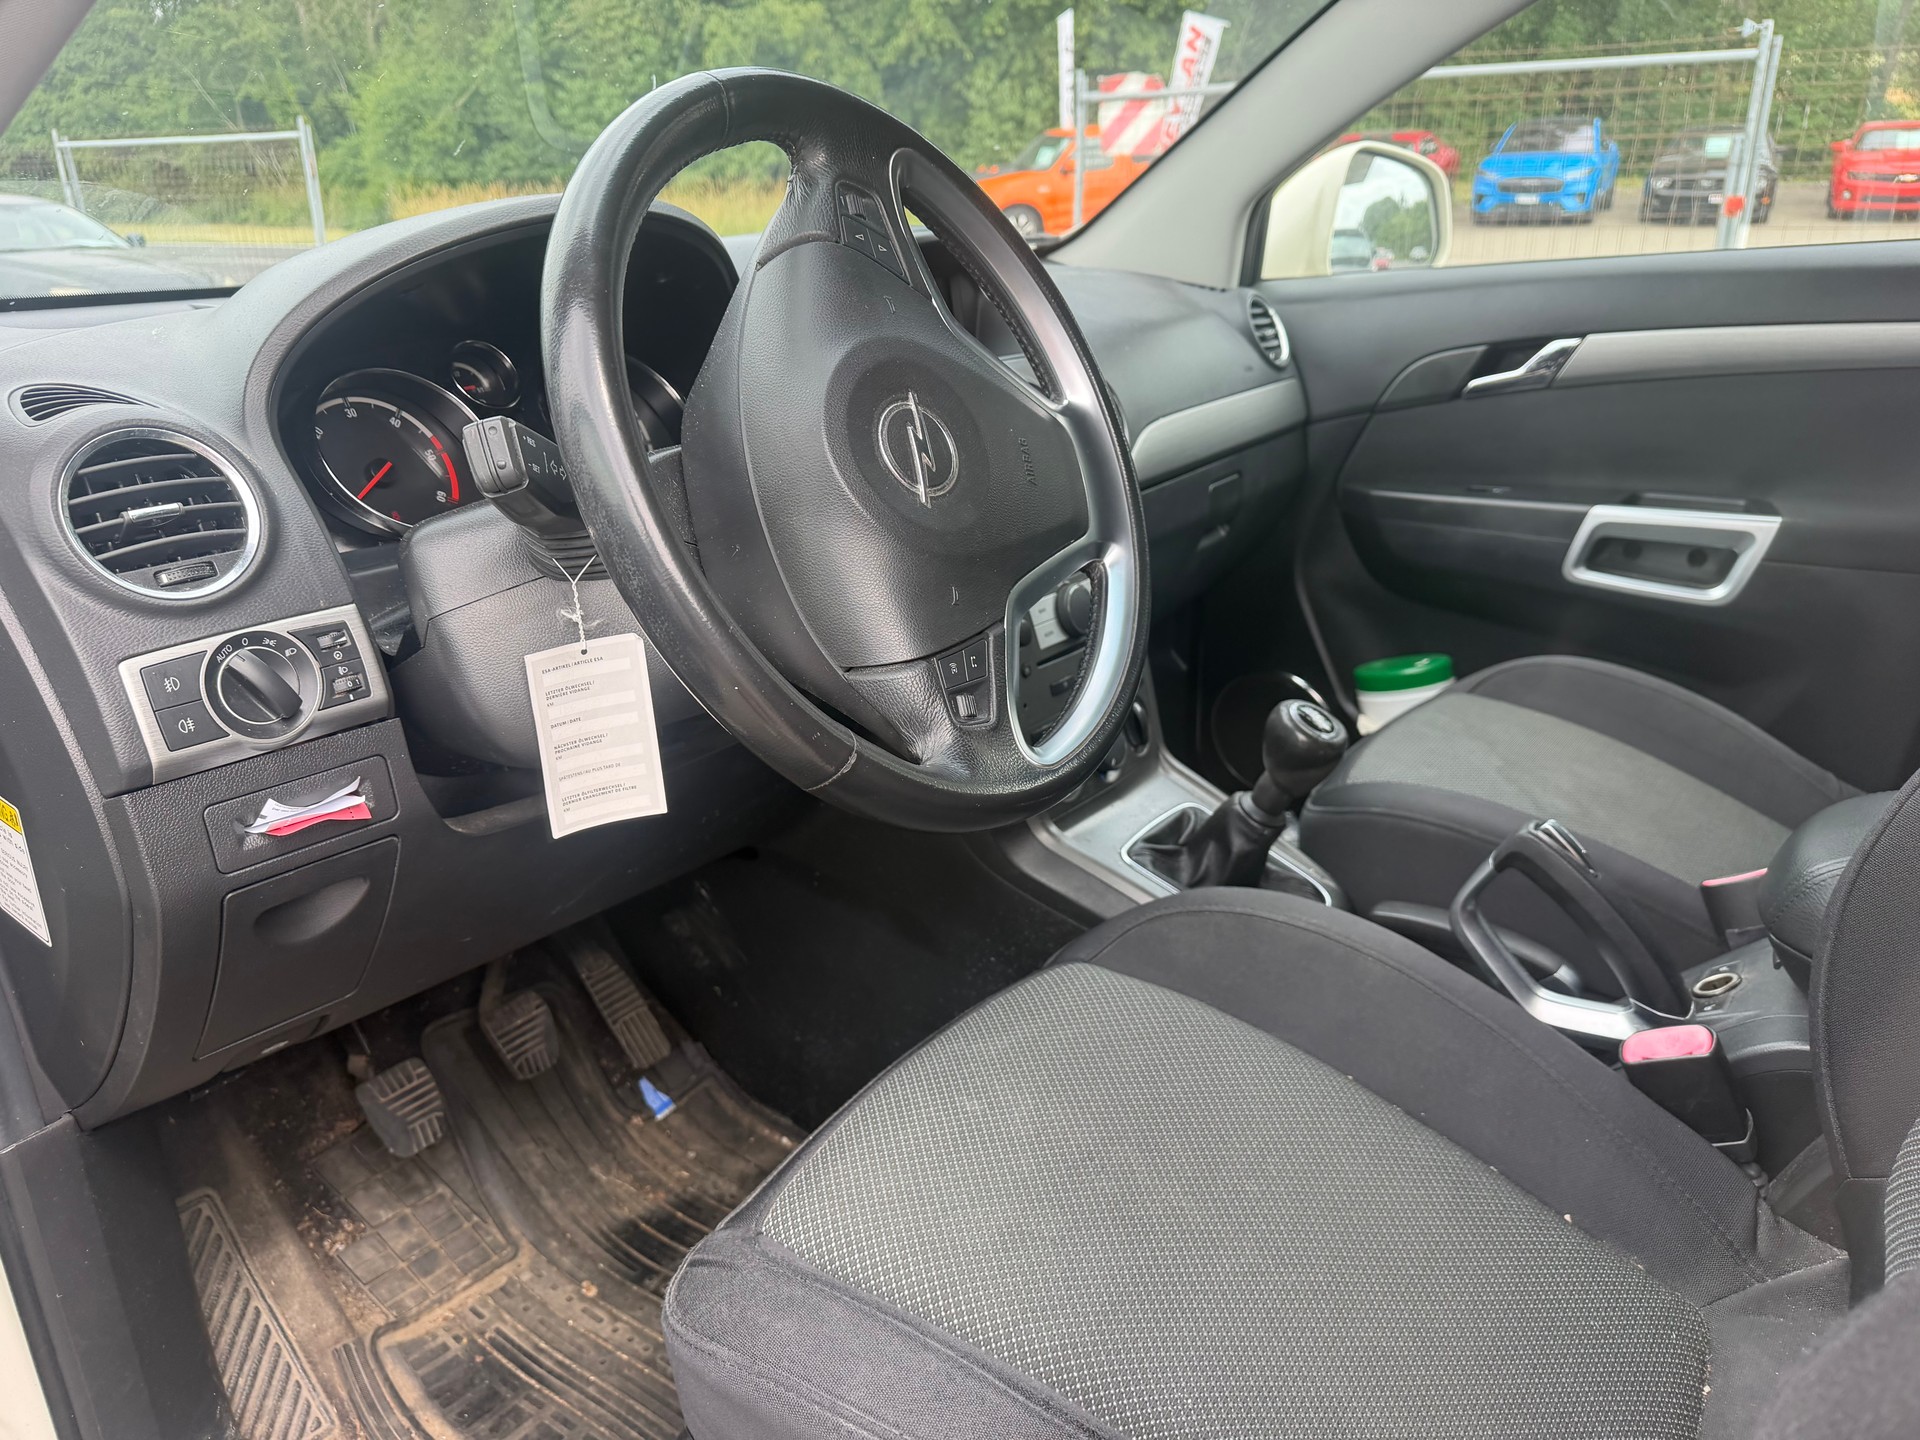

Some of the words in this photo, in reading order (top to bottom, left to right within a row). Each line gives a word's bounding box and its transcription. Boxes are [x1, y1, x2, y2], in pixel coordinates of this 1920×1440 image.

[344, 408, 357, 418] 30
[389, 417, 401, 428] 40
[425, 449, 436, 462] 50
[1019, 438, 1038, 486] AIRBAG
[437, 491, 447, 502] 60
[216, 644, 233, 663] AUTO
[545, 688, 564, 696] LETZTER
[551, 721, 567, 729] DATUM
[555, 745, 580, 754] PROCHAINE
[562, 793, 580, 802] LETZTER
[583, 791, 614, 801] CHANGEMENT
